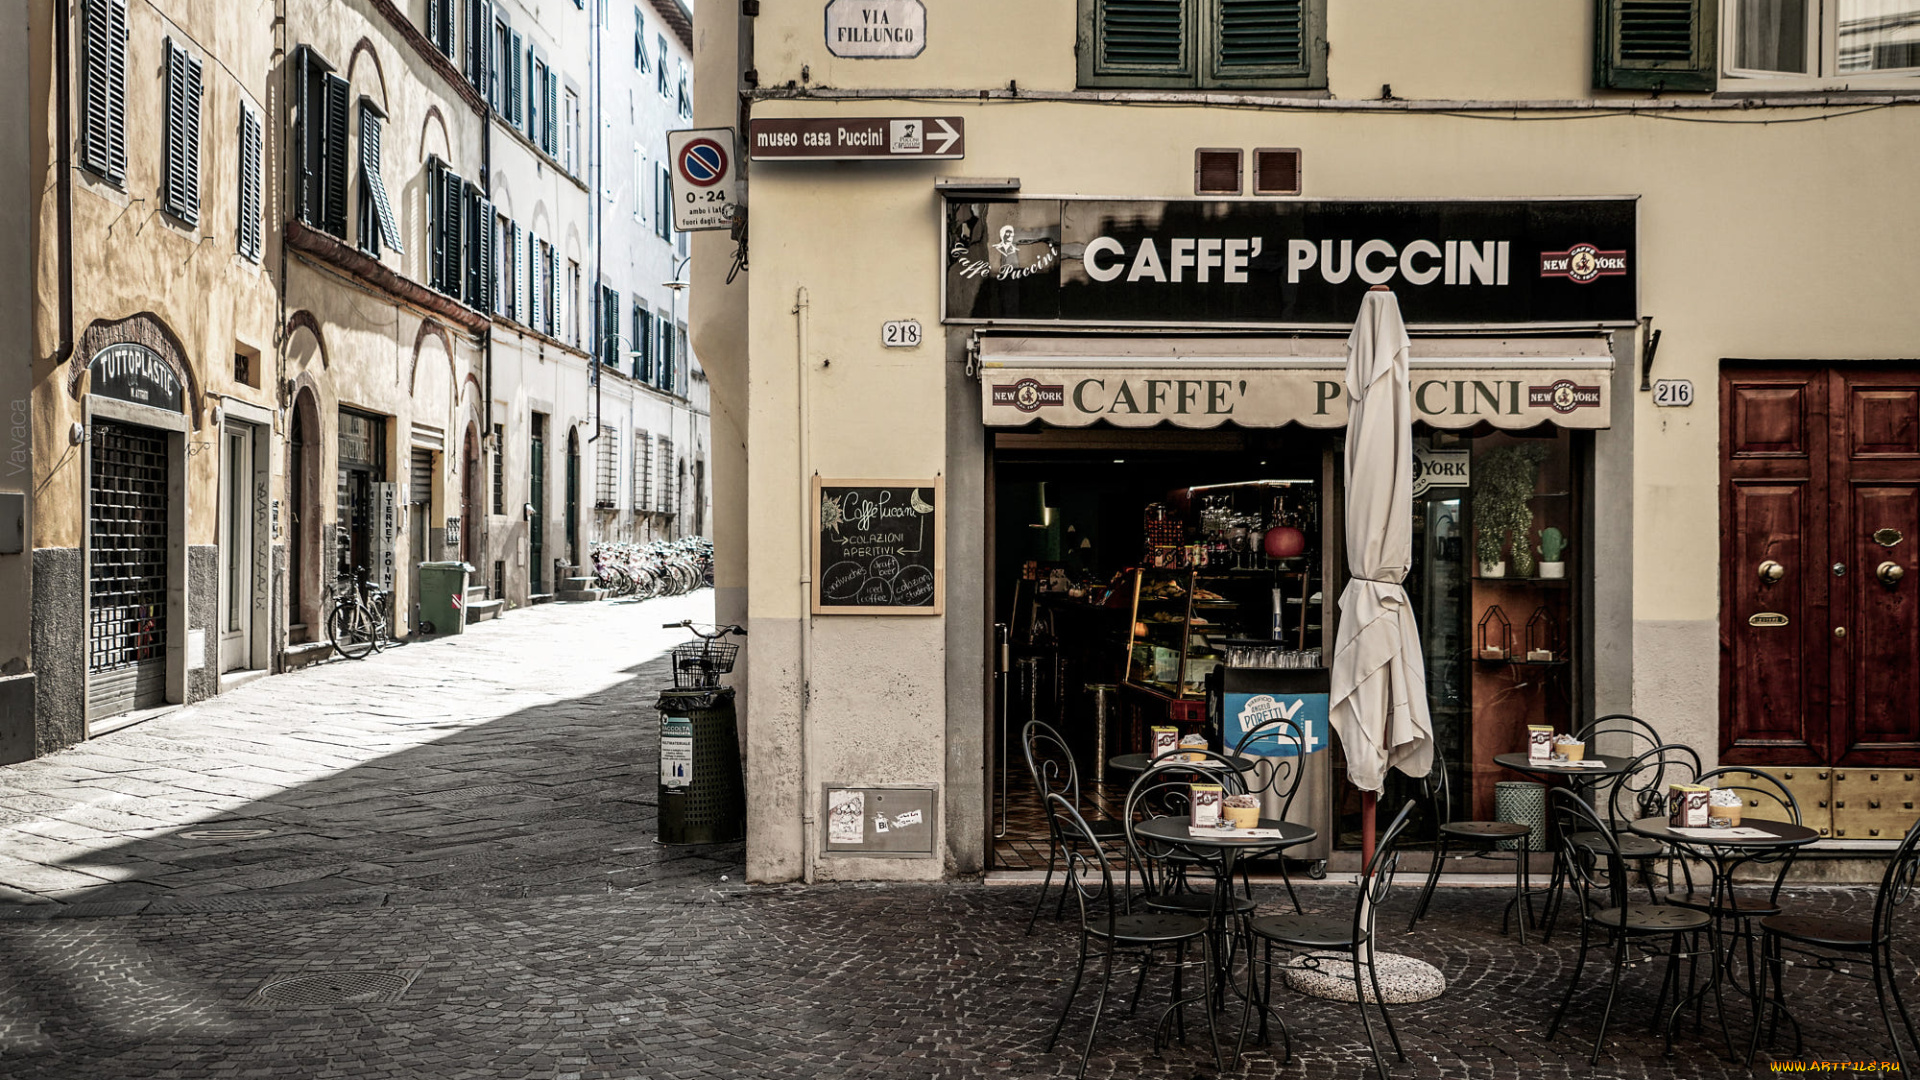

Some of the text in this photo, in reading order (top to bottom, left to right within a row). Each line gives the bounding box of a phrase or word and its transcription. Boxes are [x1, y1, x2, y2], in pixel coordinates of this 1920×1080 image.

[862, 9, 889, 24] VIA
[838, 27, 913, 43] FILLUNGO
[757, 130, 798, 147] museo
[803, 130, 831, 147] casa
[838, 127, 883, 147] Puccini
[686, 192, 696, 204] 0
[706, 190, 726, 202] 24
[689, 207, 707, 215] ambo
[997, 243, 1058, 281] Puccini
[1083, 236, 1510, 285] CAFFE' PUCCINI
[1543, 256, 1626, 271] NEW YORK
[887, 324, 917, 343] 218
[100, 349, 174, 397] TUTTOPLASTIC
[994, 390, 1063, 401] NEW YORK
[1072, 378, 1524, 416] CAFFE' PCINI
[1531, 391, 1599, 402] NEW YORK
[1658, 384, 1689, 402] 216
[1423, 460, 1467, 476] YORK
[384, 484, 394, 589] INTERNET POINT
[849, 533, 905, 545] COLAZIONI
[843, 546, 895, 557] APERITIVI
